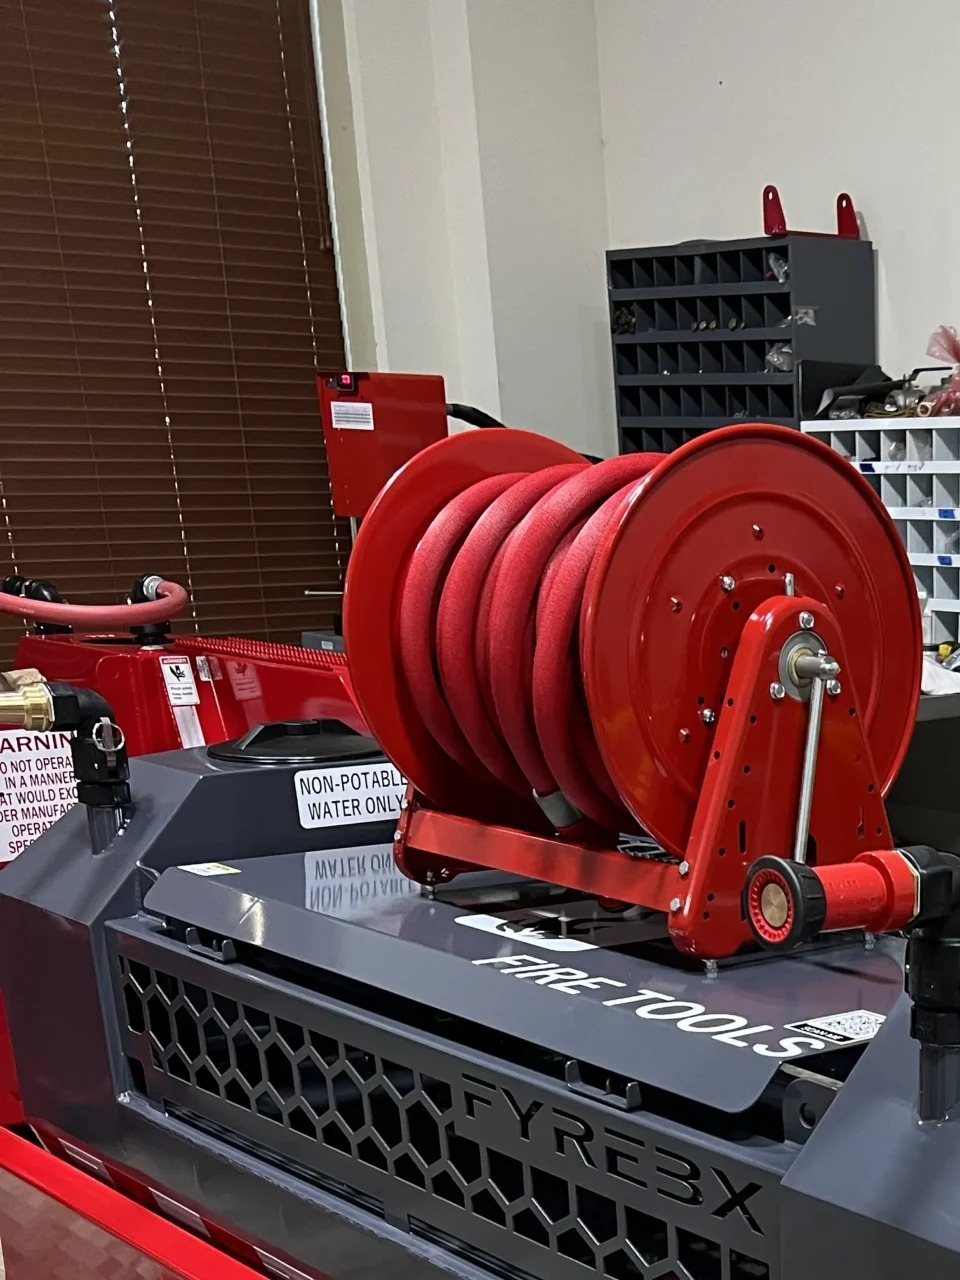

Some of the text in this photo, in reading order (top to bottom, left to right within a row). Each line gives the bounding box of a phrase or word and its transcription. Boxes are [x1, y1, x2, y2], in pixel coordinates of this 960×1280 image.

[10, 759, 32, 773] NOT
[4, 770, 77, 790] IN A MANNER
[299, 769, 410, 796] NON-POTABLE
[15, 788, 56, 805] WOULD
[20, 802, 78, 821] MANUFAC
[307, 793, 406, 821] WATER ONLY
[471, 954, 826, 1058] FIRE TOOLS
